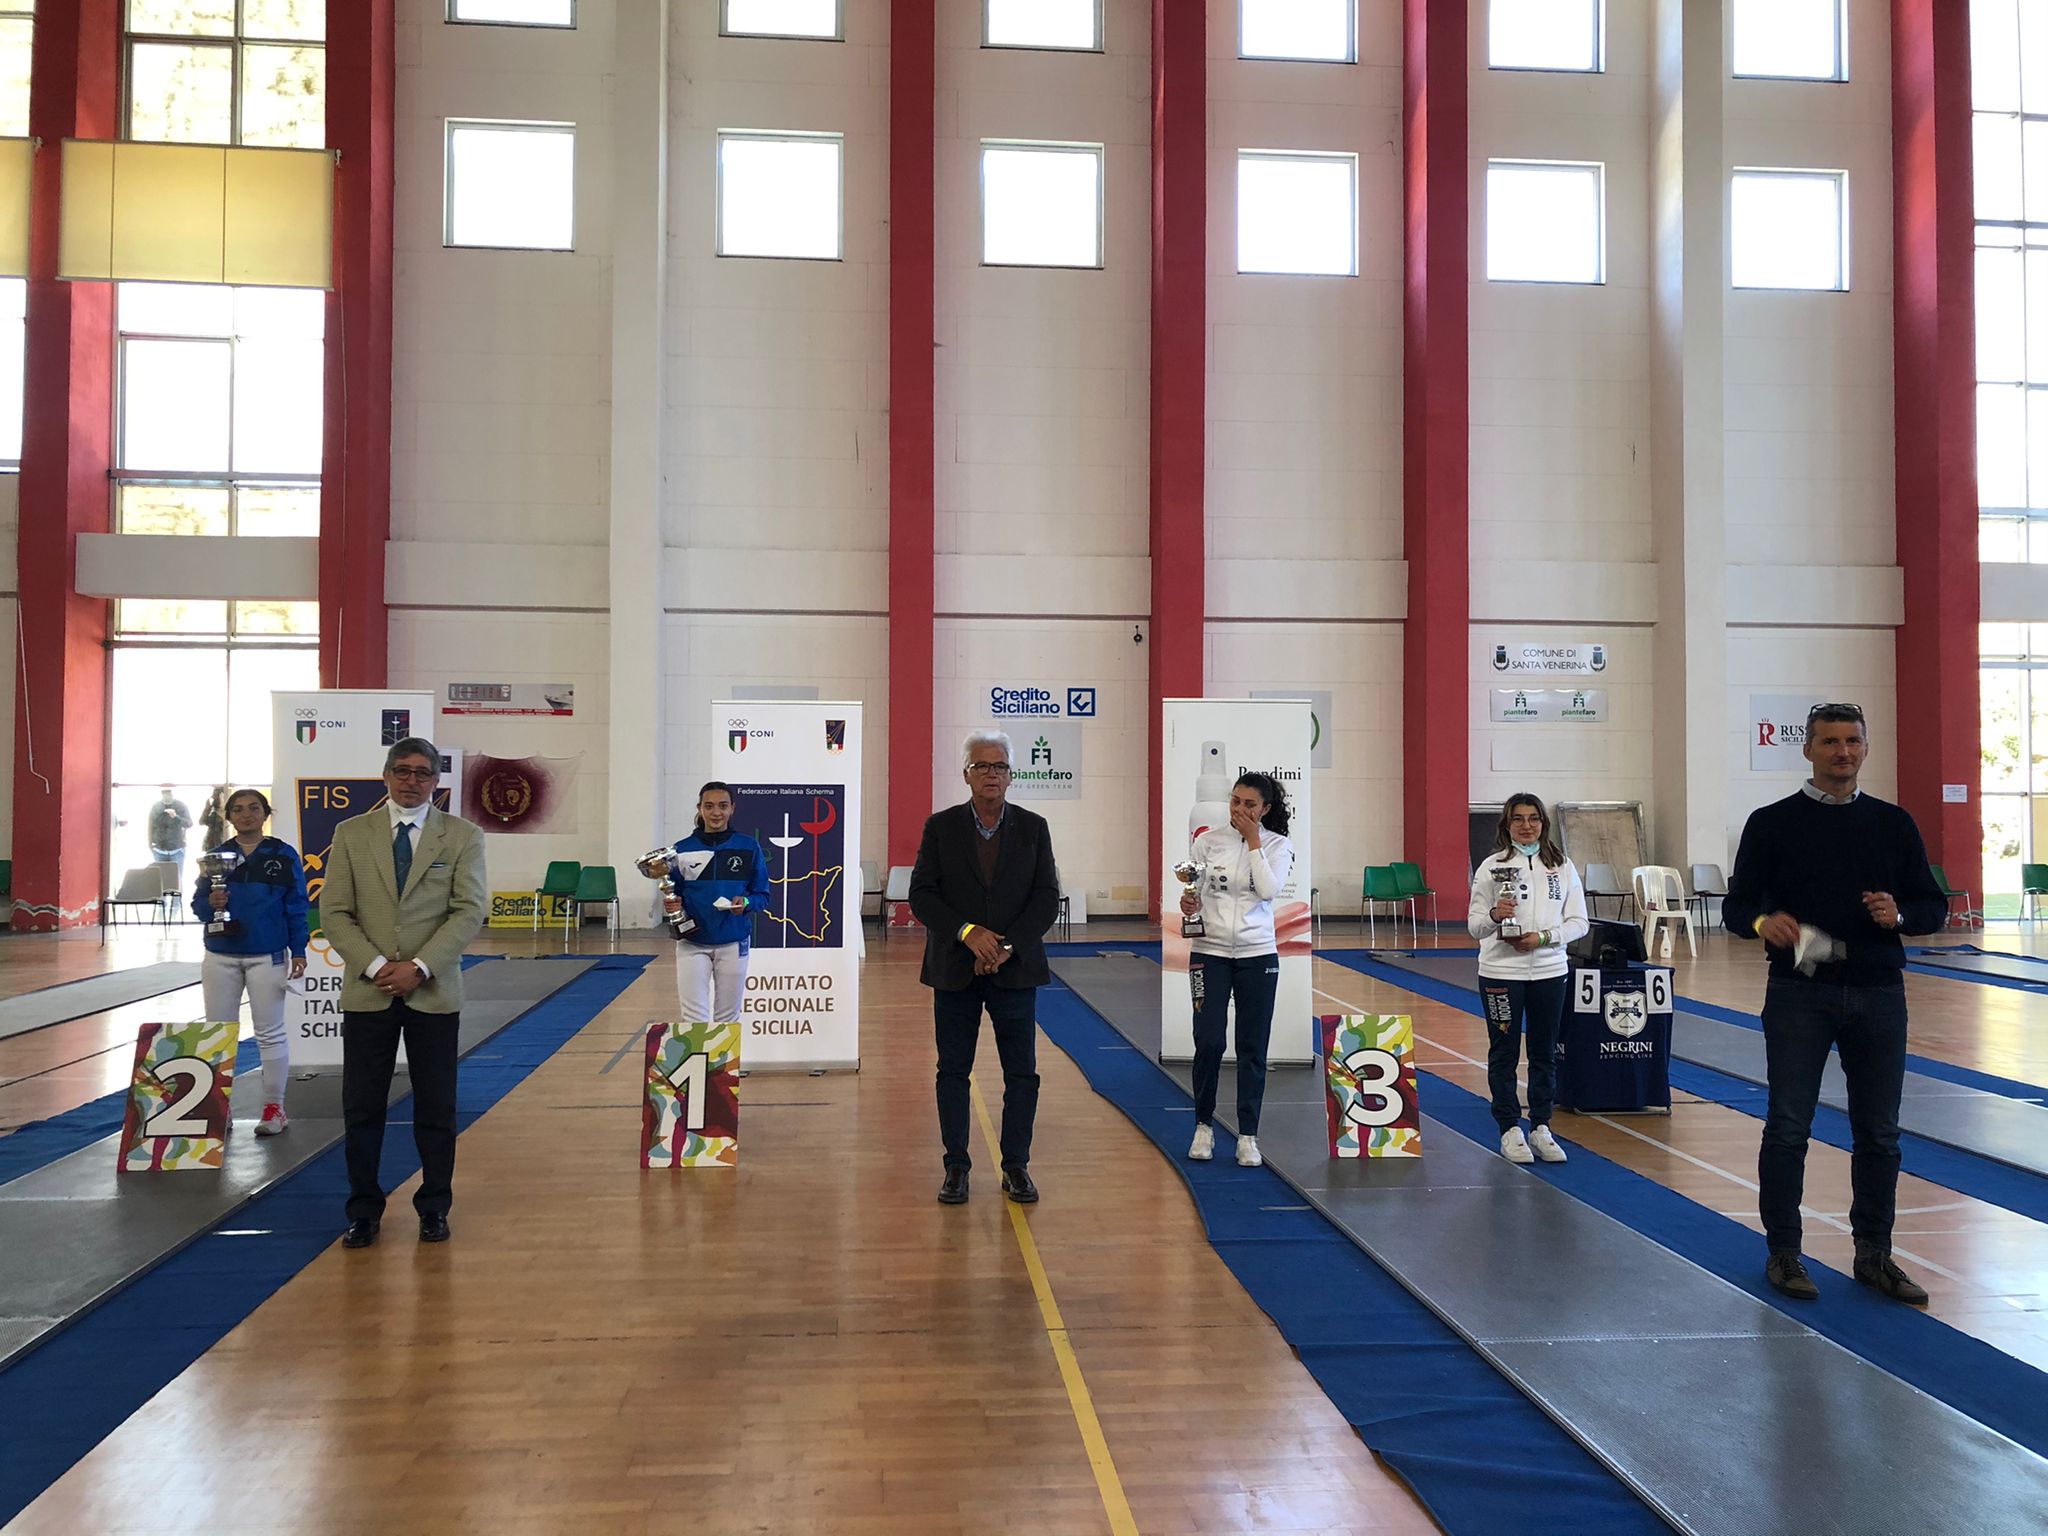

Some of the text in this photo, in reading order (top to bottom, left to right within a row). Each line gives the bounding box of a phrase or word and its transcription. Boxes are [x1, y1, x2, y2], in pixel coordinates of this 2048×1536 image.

[1522, 649, 1577, 658] COMUNE DI
[1511, 661, 1588, 670] SANTA VENERINA
[990, 686, 1051, 701] Credito
[991, 700, 1061, 714] Siciliano
[319, 720, 346, 729] CONI
[1780, 724, 1806, 737] RUS
[749, 730, 775, 738] CONI
[303, 785, 351, 809] FIS
[737, 787, 835, 796] Federazione Italiana Scherma
[1553, 874, 1562, 901] MODICA
[491, 896, 542, 908] Credito
[491, 905, 547, 917] Siciliano
[745, 975, 833, 991] OMITATO
[1194, 969, 1206, 999] MODICA
[1581, 974, 1595, 1005] 5
[1652, 974, 1666, 1006] 6
[740, 997, 835, 1013] EGIONALE
[1496, 993, 1513, 1021] MODICA
[751, 1019, 814, 1035] SICILIA
[1599, 1041, 1654, 1054] NEGRINI
[667, 1052, 709, 1131] 1
[1342, 1047, 1404, 1128] 3
[143, 1055, 214, 1138] 2
